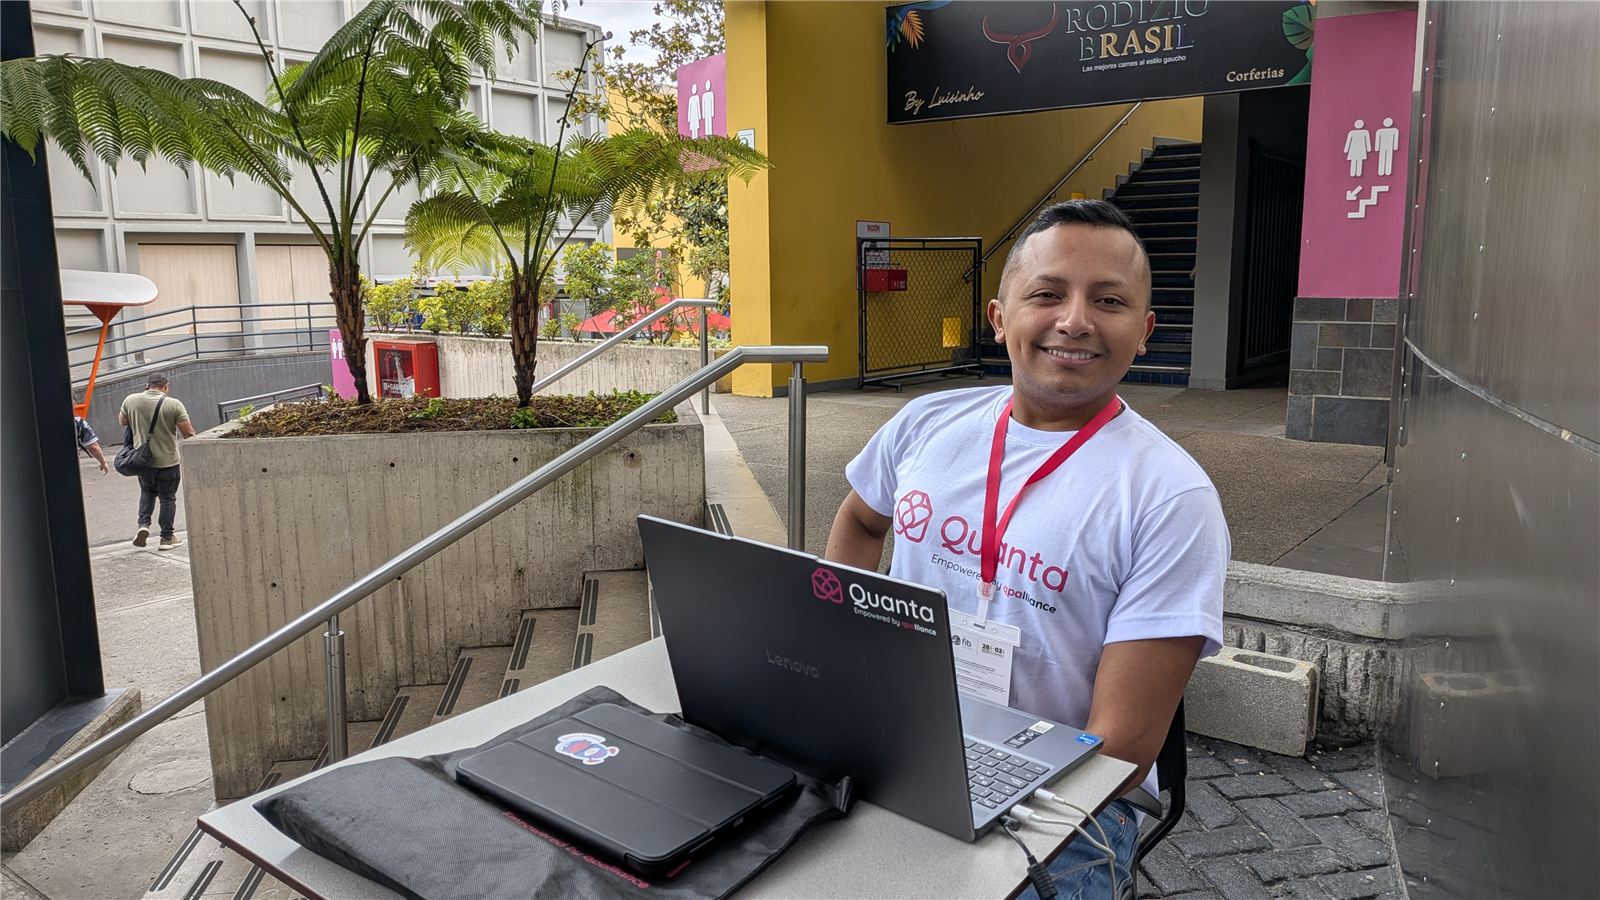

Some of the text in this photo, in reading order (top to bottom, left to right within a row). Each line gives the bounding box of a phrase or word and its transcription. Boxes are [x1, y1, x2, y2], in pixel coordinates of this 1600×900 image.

[1066, 0, 1208, 34] RODIZIO
[1079, 24, 1194, 61] BRASIL
[1094, 63, 1117, 71] mejores
[1146, 57, 1162, 65] estilo
[1163, 55, 1187, 64] gaucho
[904, 85, 985, 115] By Luisinho
[931, 553, 983, 581] Empowere
[848, 583, 935, 624] Quanta
[853, 607, 891, 624] Empowered
[891, 617, 901, 628] by
[765, 649, 821, 679] Lenovo
